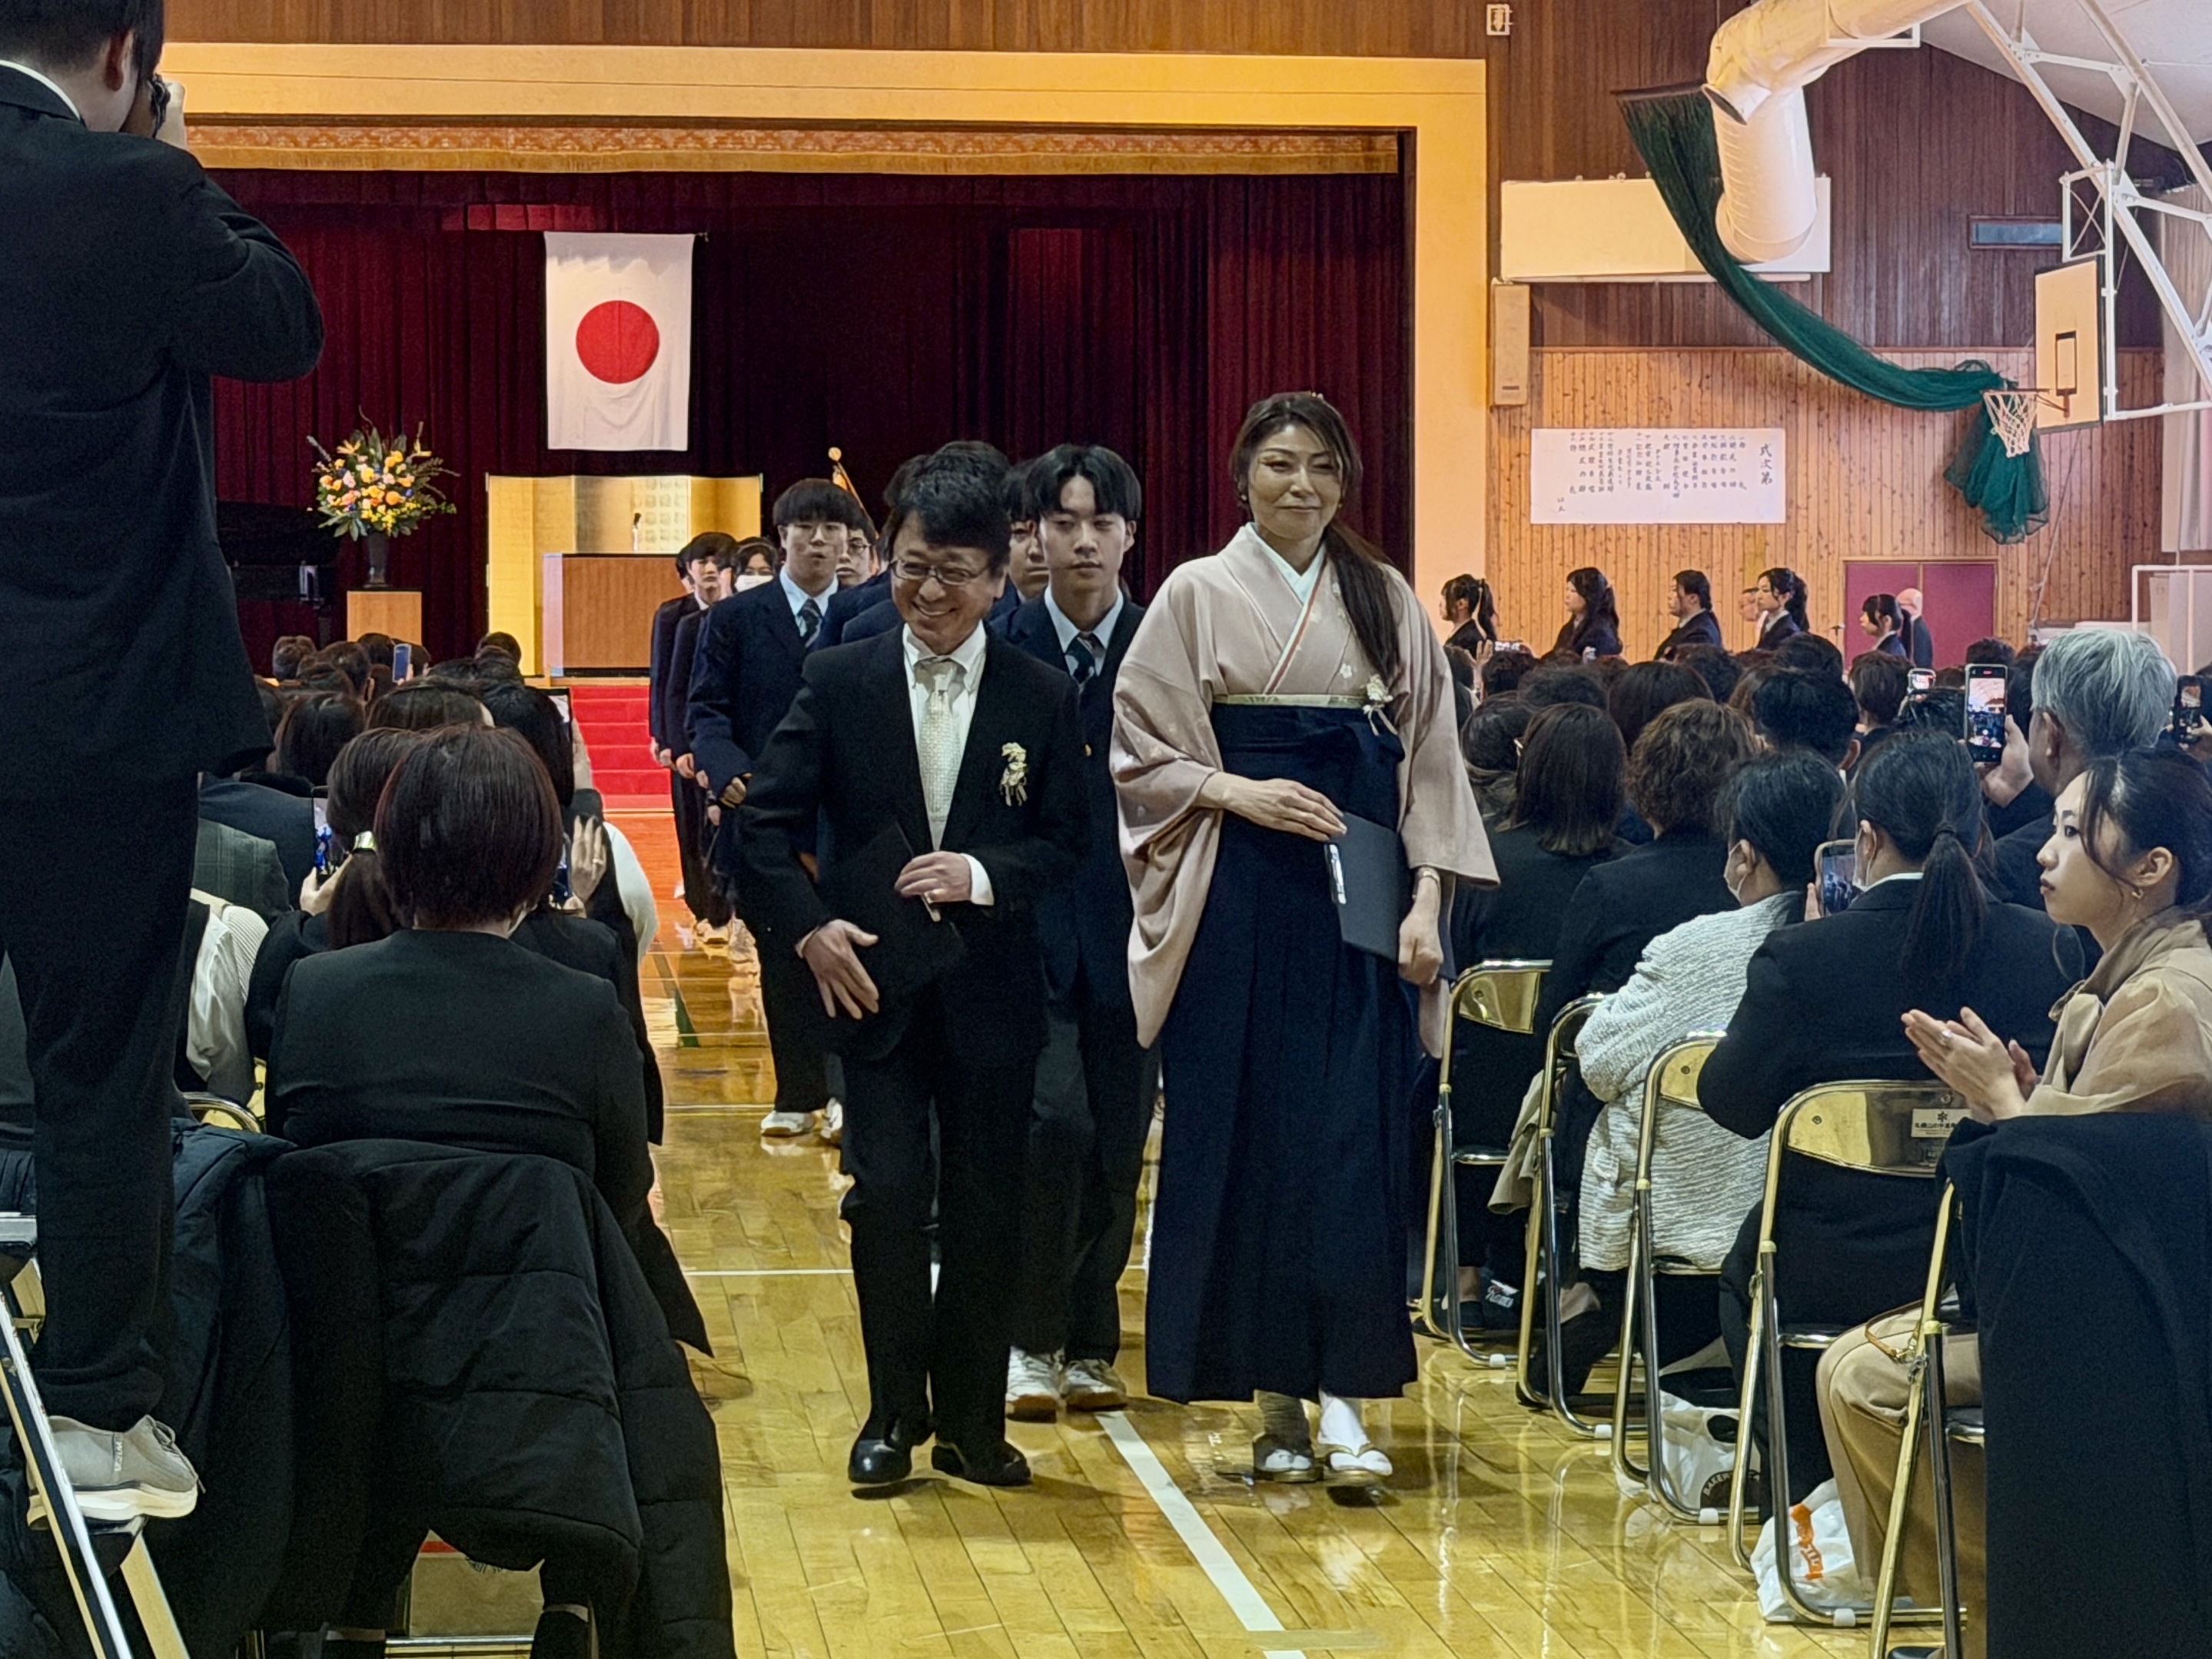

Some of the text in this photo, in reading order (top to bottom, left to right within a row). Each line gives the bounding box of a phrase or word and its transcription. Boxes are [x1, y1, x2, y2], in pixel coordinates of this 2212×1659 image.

[1759, 443, 1773, 485] 式次第
[1702, 1472, 1733, 1496] BAKER
